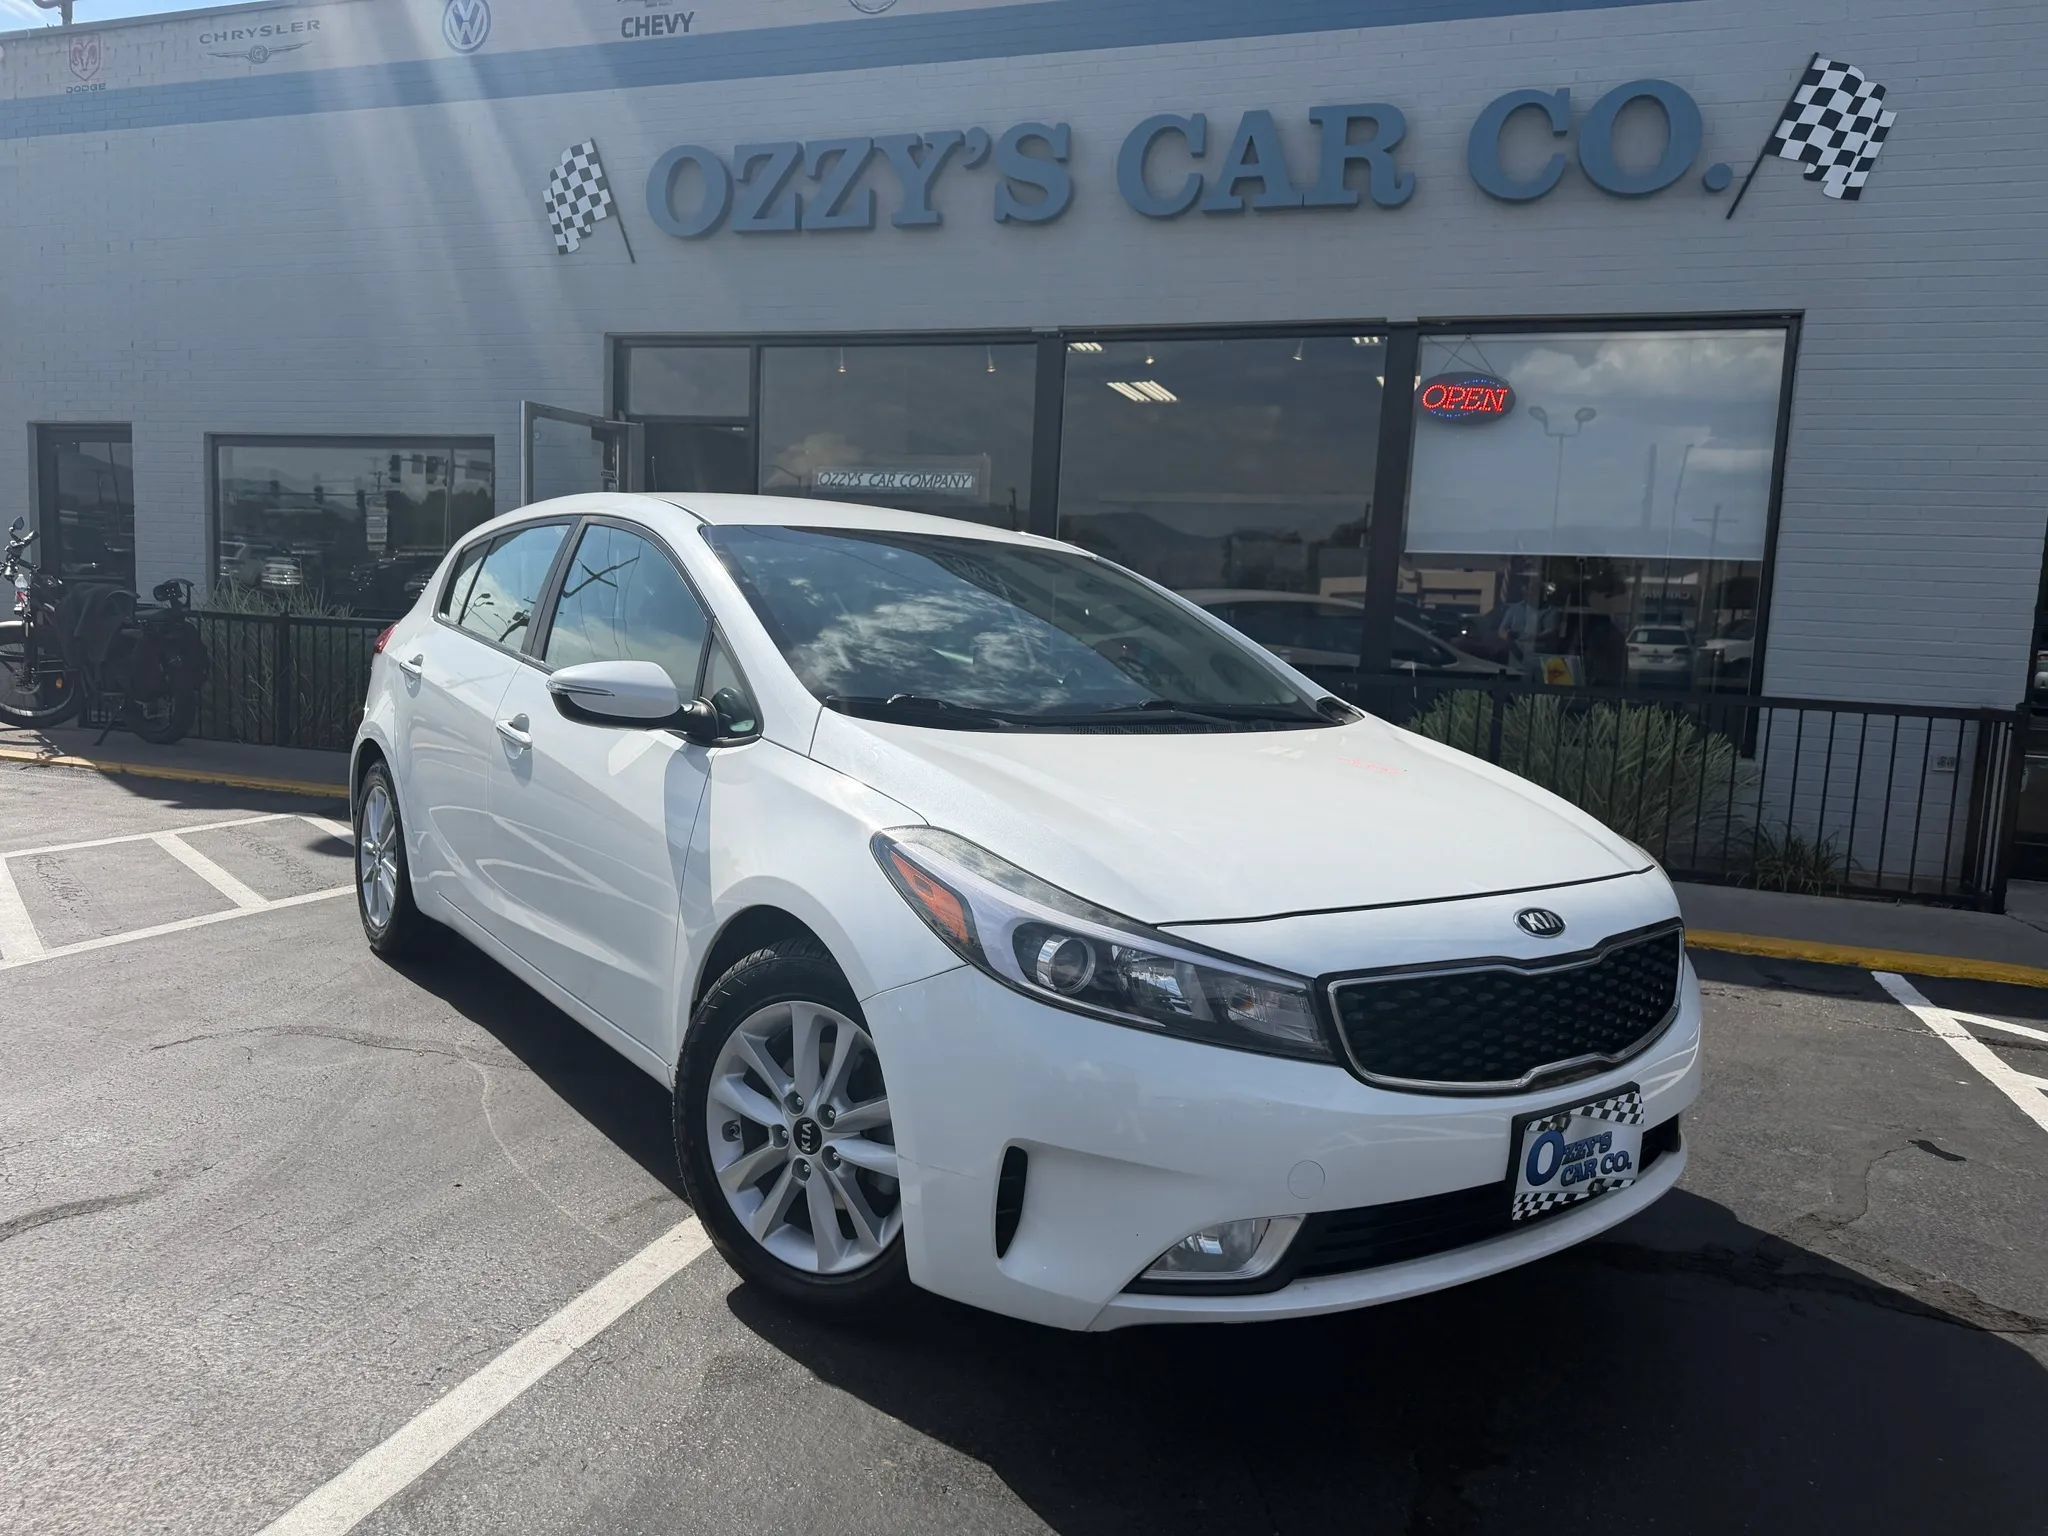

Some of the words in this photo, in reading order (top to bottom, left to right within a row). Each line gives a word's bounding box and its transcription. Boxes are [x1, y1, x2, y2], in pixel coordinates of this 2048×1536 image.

[199, 19, 321, 45] CHRYSLER
[621, 11, 694, 38] CHEVY
[65, 82, 106, 94] DODGE
[646, 121, 1074, 240] OZZY'S
[1116, 102, 1416, 221] CAR
[1467, 78, 1735, 204] CO.
[1422, 384, 1509, 413] OPEN
[868, 472, 895, 488] CAR
[899, 473, 971, 488] COMPANY
[1520, 911, 1563, 931] KIA
[802, 1122, 812, 1151] KIA
[1560, 1157, 1598, 1187] CAR
[1600, 1150, 1632, 1175] CO.
